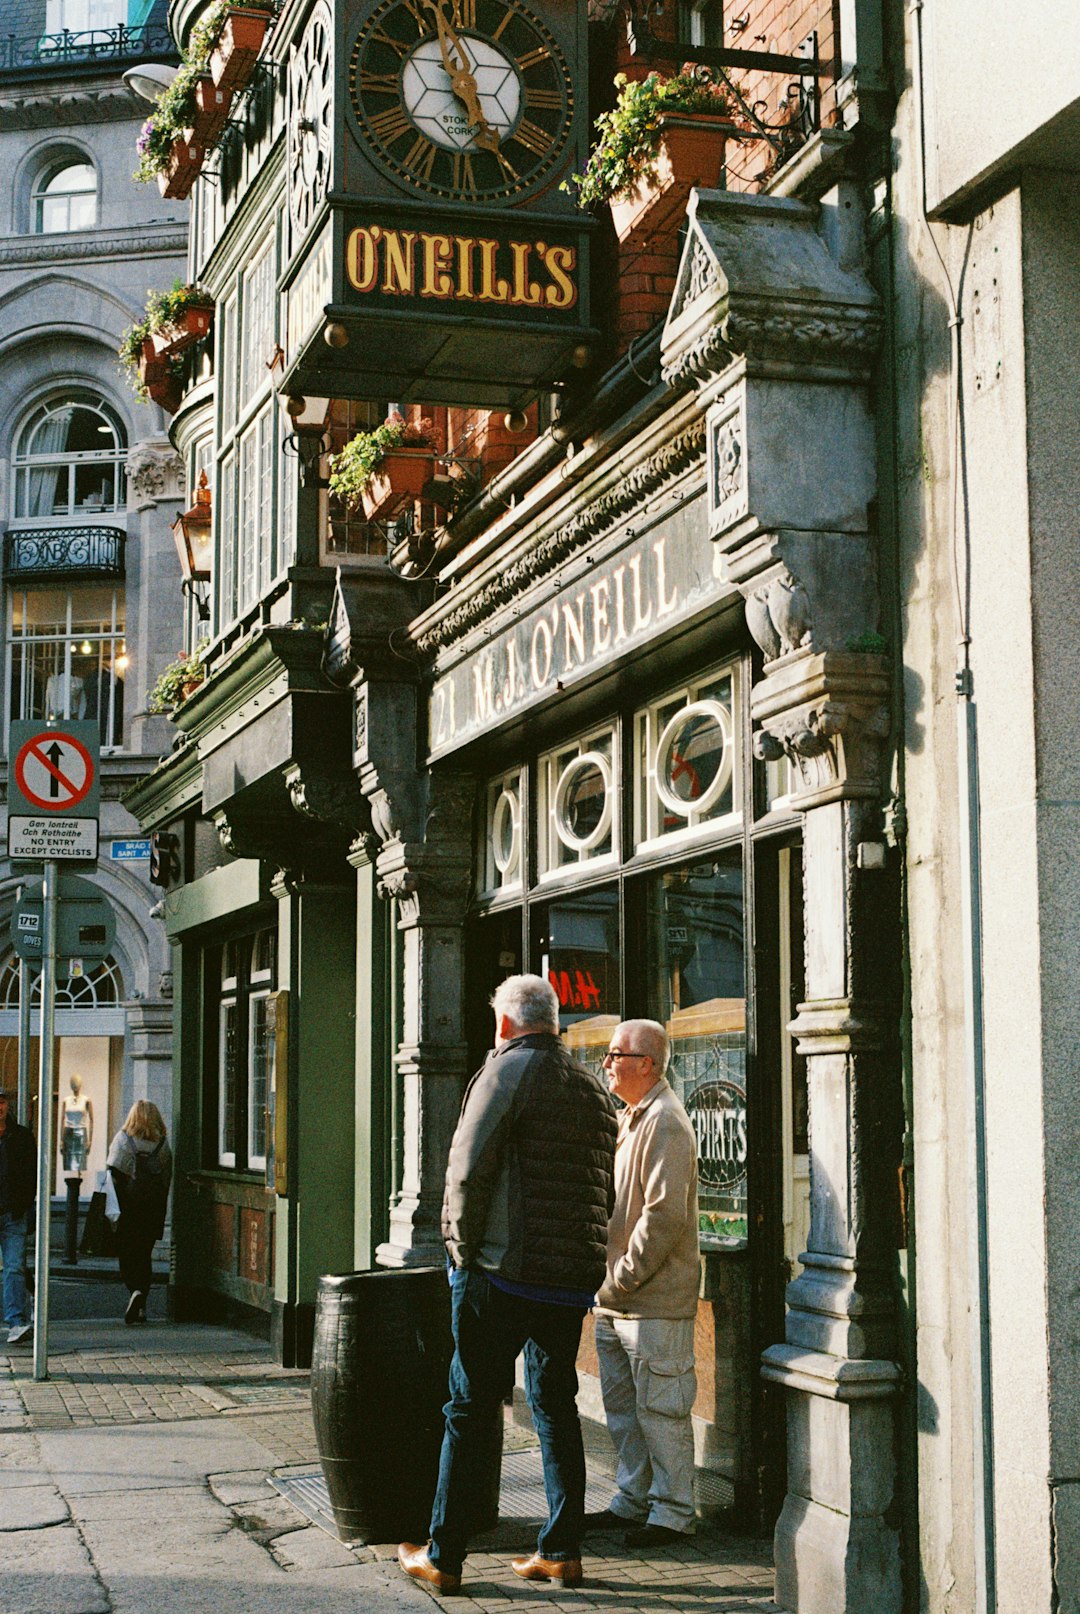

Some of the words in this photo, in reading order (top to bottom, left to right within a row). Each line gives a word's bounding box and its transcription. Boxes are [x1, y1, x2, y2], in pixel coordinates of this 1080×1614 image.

[443, 115, 469, 125] STOK
[447, 126, 473, 136] CORK
[346, 225, 577, 309] O'NEILL'S
[530, 537, 678, 689] O'NEILL
[28, 820, 46, 828] Gan
[47, 838, 75, 846] ENTRY
[49, 848, 92, 856] CYCLISTS
[20, 916, 38, 926] 1712
